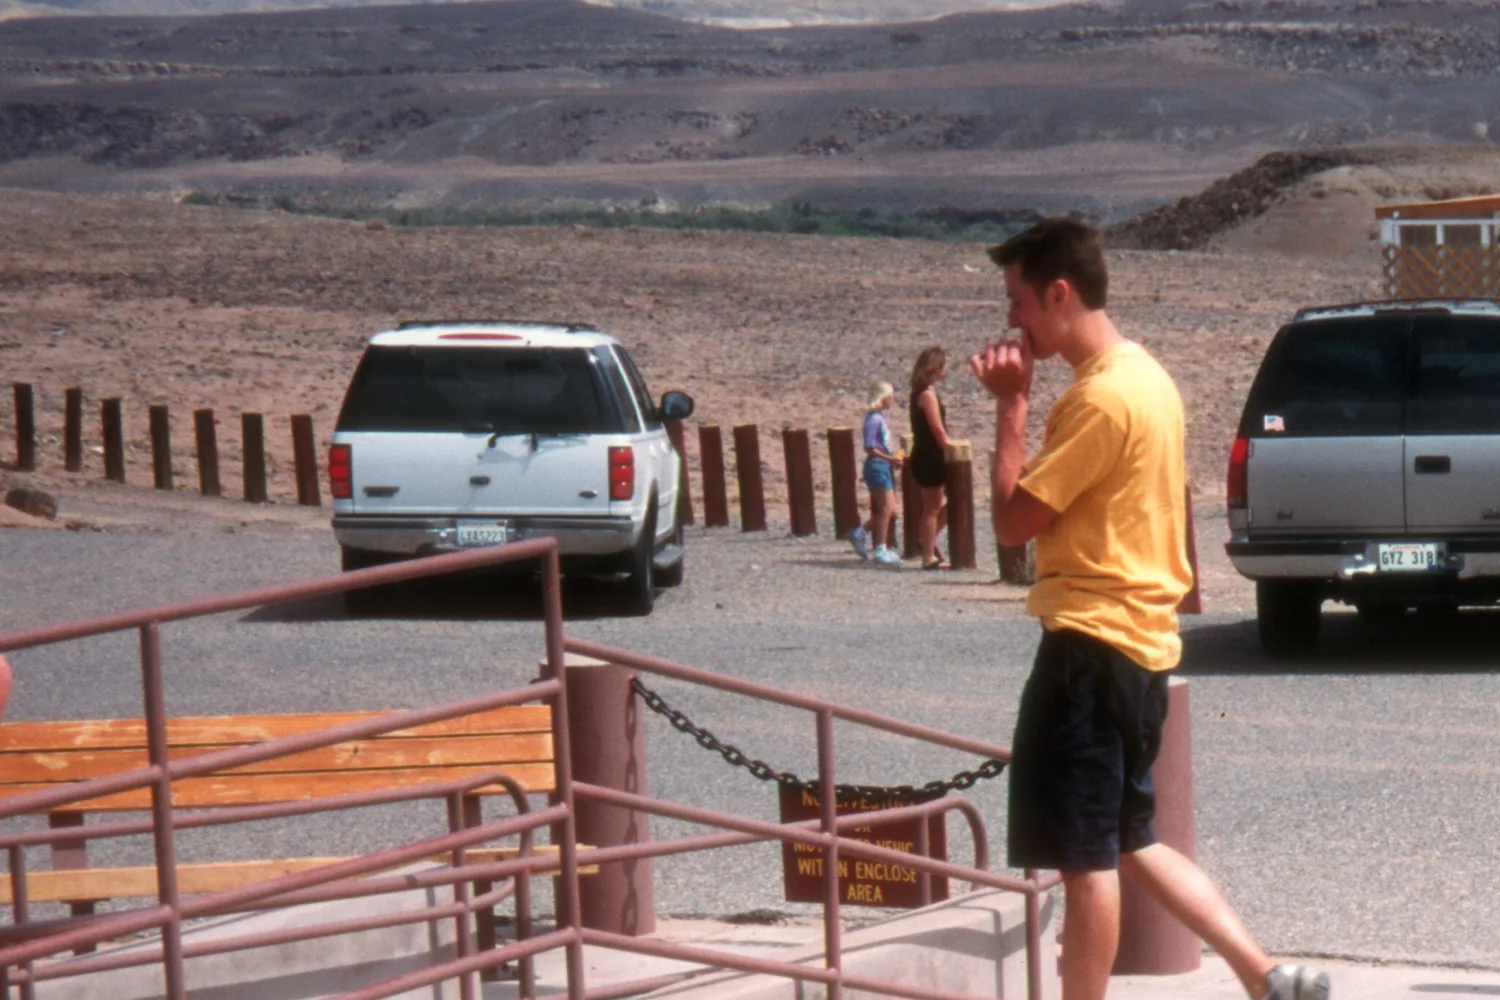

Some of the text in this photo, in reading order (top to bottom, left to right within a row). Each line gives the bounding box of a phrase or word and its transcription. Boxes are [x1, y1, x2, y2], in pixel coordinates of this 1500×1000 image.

[1381, 550, 1434, 565] GYZ 318
[847, 883, 884, 902] AREA
